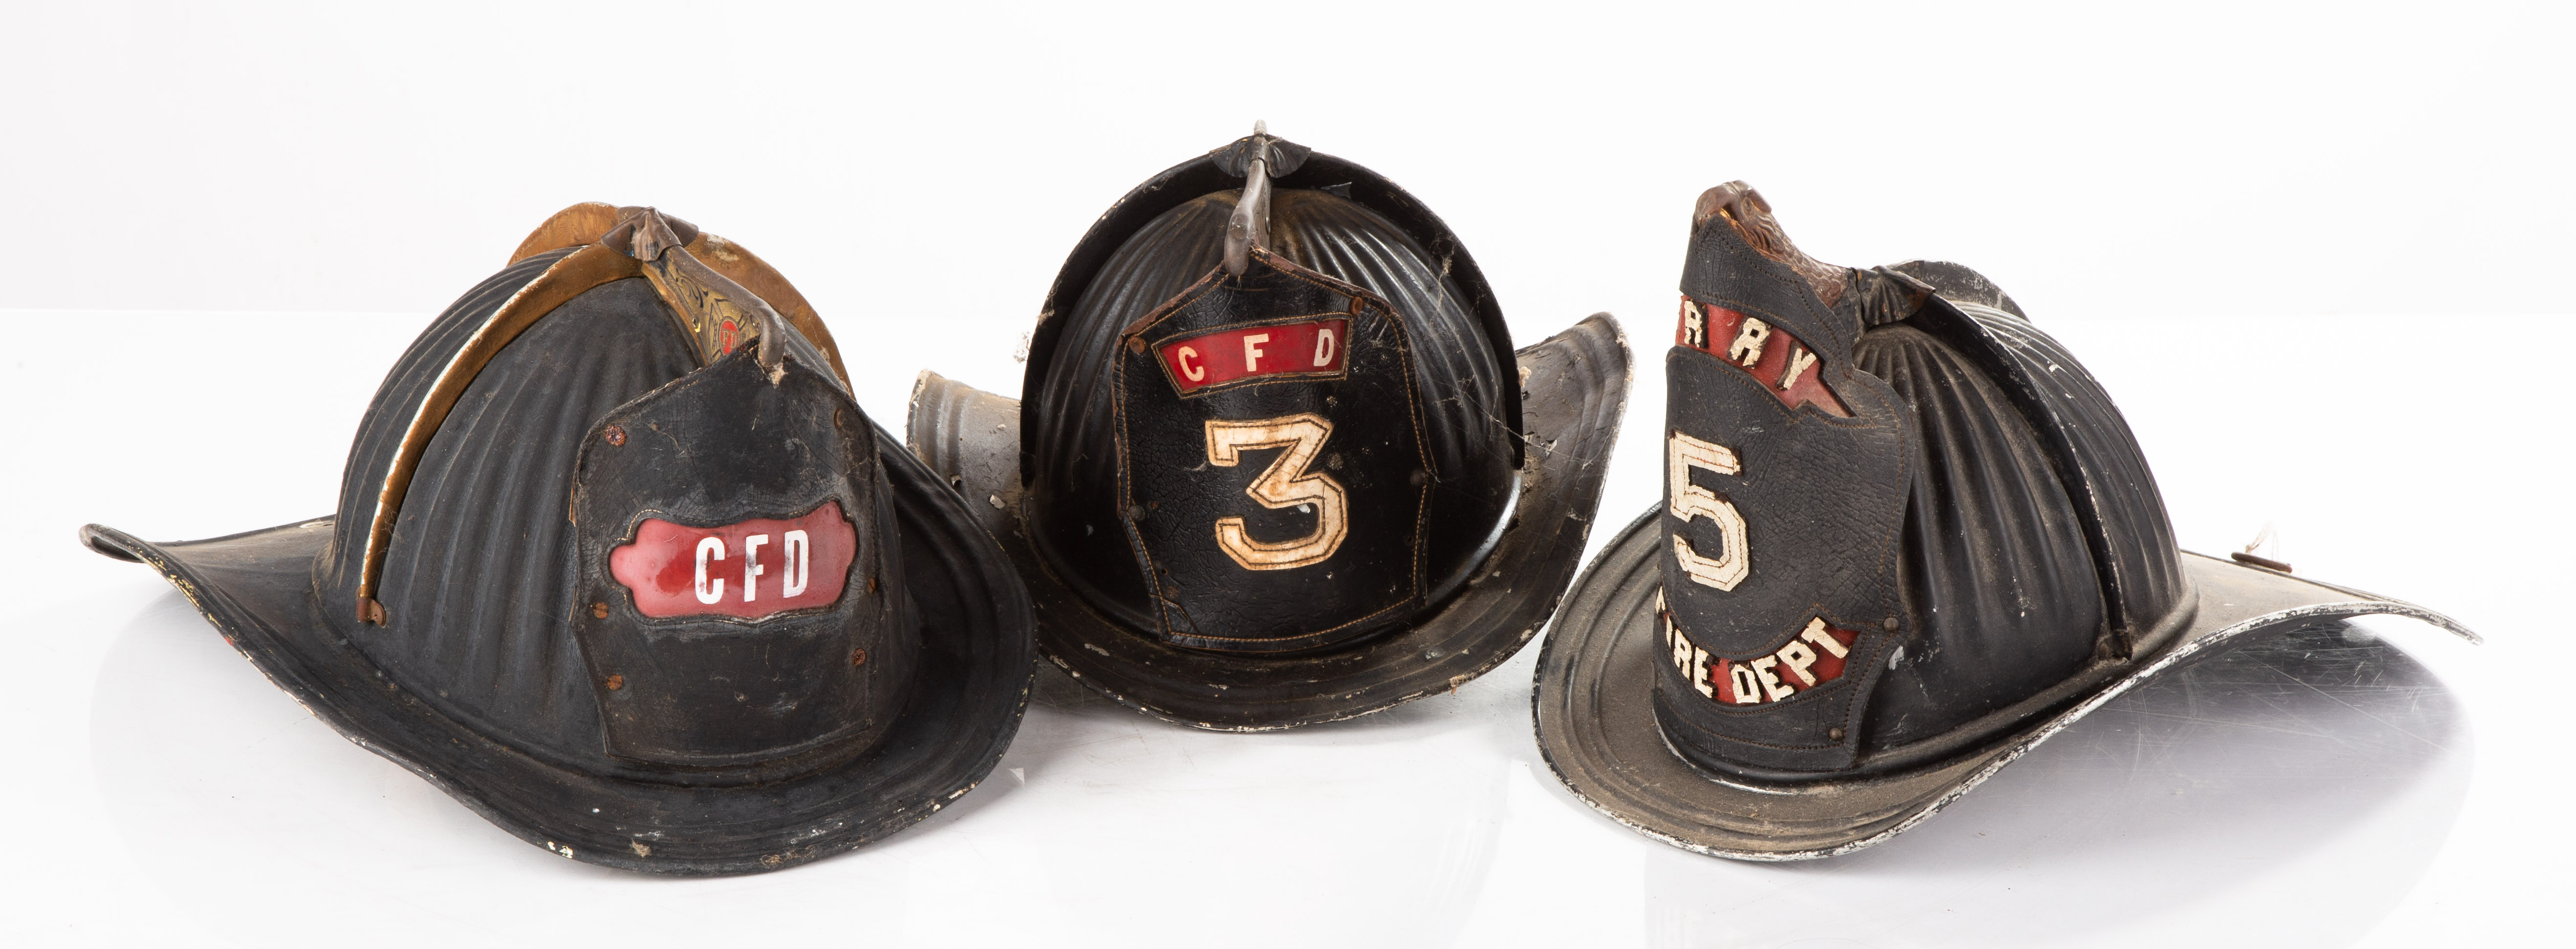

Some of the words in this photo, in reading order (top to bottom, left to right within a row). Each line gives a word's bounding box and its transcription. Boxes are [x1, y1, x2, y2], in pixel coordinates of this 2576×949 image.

[1205, 412, 1348, 571] 3
[1669, 431, 1749, 592] 5
[695, 529, 809, 604] CFD
[1730, 617, 1850, 704] DEPT
